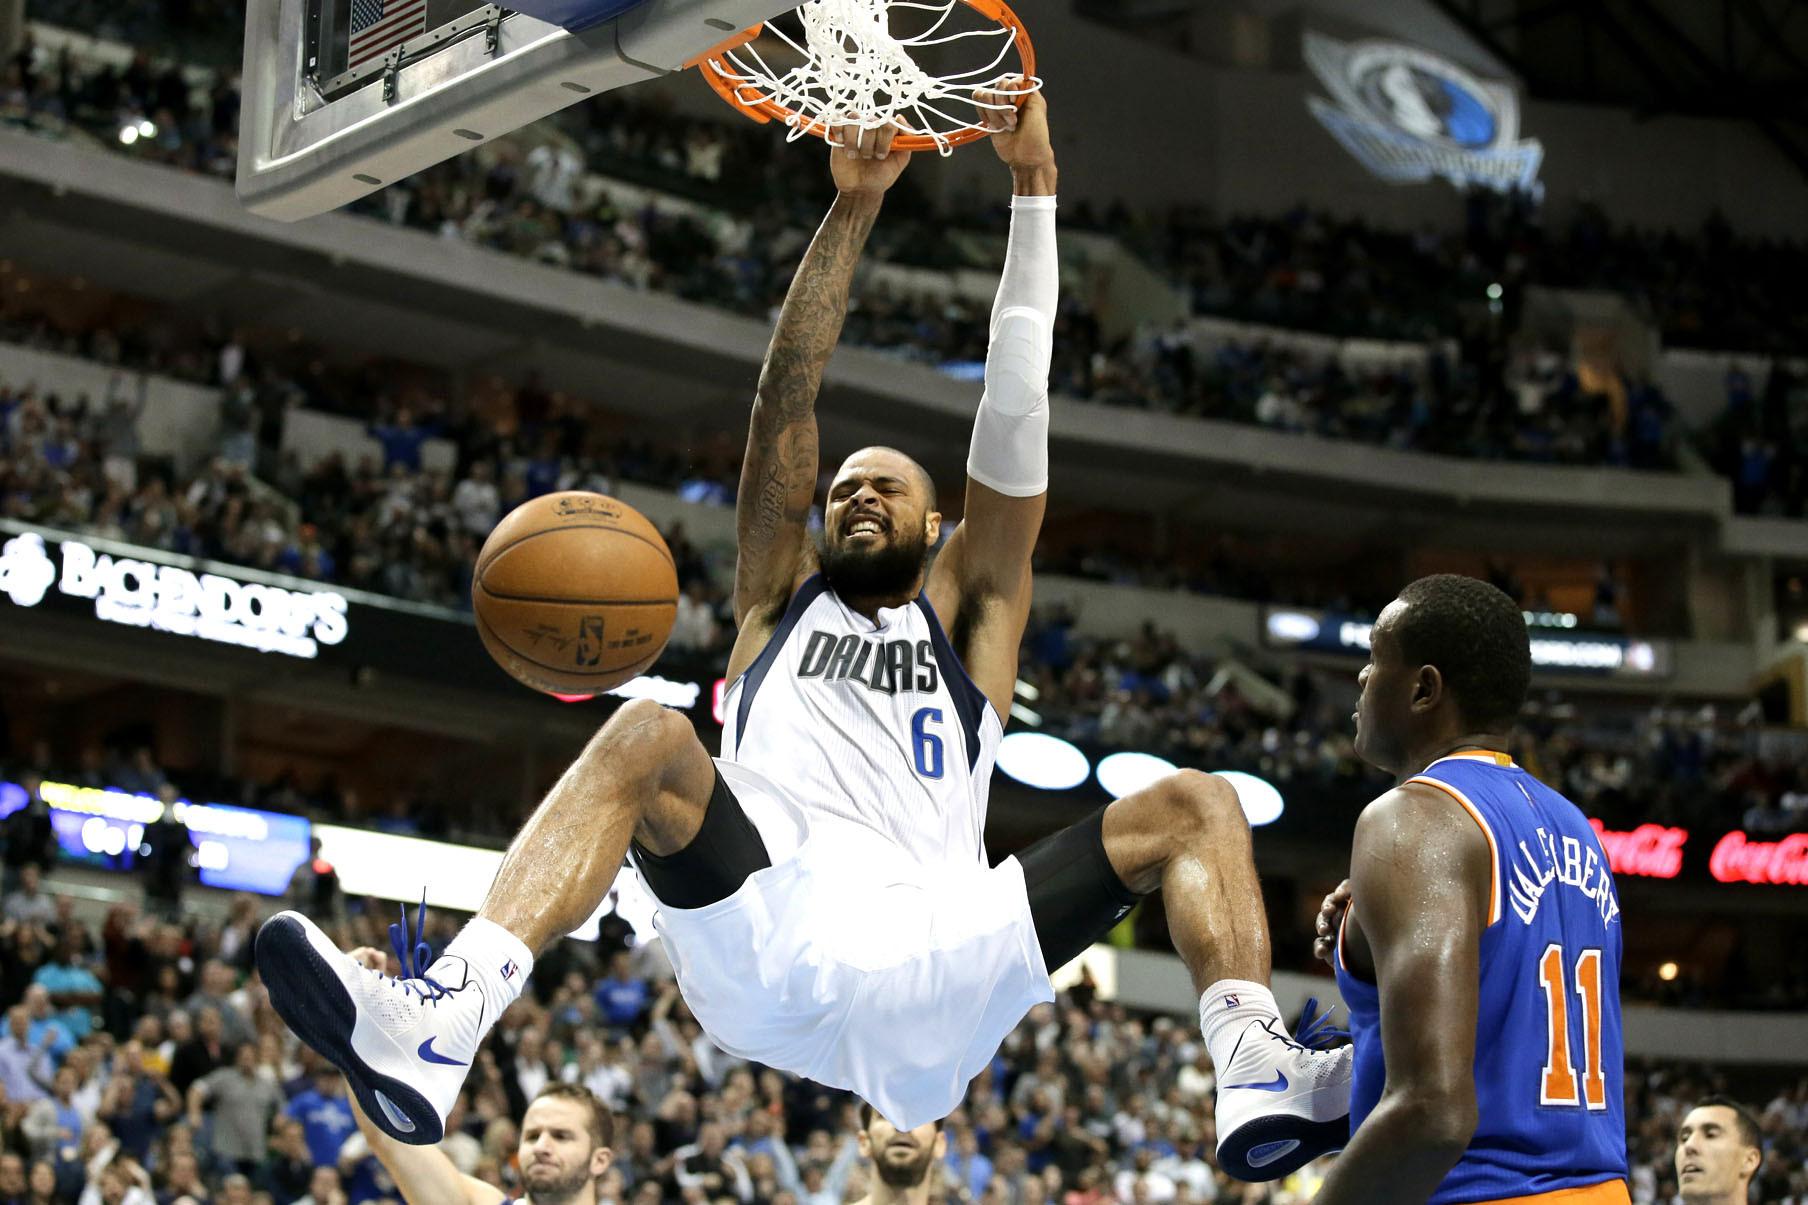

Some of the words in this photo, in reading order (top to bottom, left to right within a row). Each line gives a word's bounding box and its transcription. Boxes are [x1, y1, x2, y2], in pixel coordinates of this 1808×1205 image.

[797, 630, 938, 696] DALLAS
[911, 707, 944, 780] 6
[1540, 943, 1607, 1111] 11
